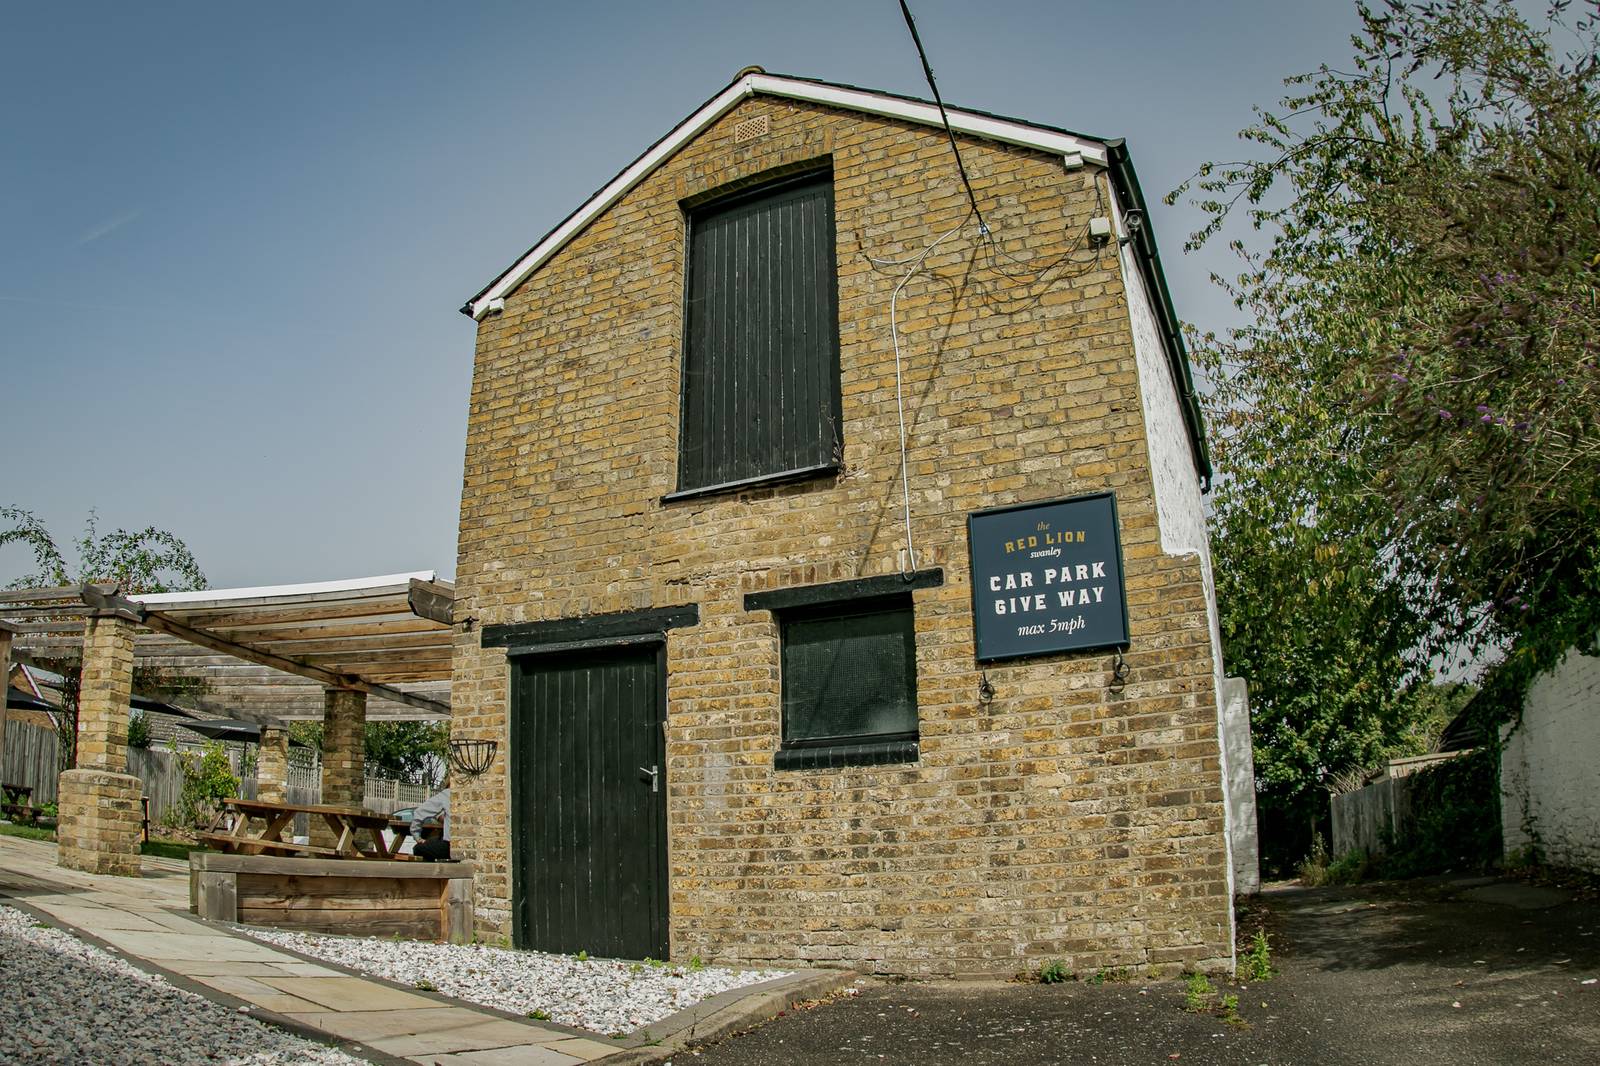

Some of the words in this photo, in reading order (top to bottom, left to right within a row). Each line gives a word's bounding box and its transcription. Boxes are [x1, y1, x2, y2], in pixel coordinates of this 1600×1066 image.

[1037, 521, 1050, 531] the
[1004, 536, 1038, 553] RED
[1046, 531, 1085, 545] LION
[1030, 547, 1062, 559] swanley
[990, 572, 1034, 591] CAR
[1045, 561, 1106, 585] PARK
[995, 594, 1047, 615] GIVE
[1058, 586, 1105, 607] WAY
[1018, 623, 1045, 636] max
[1049, 616, 1085, 635] 5mph
